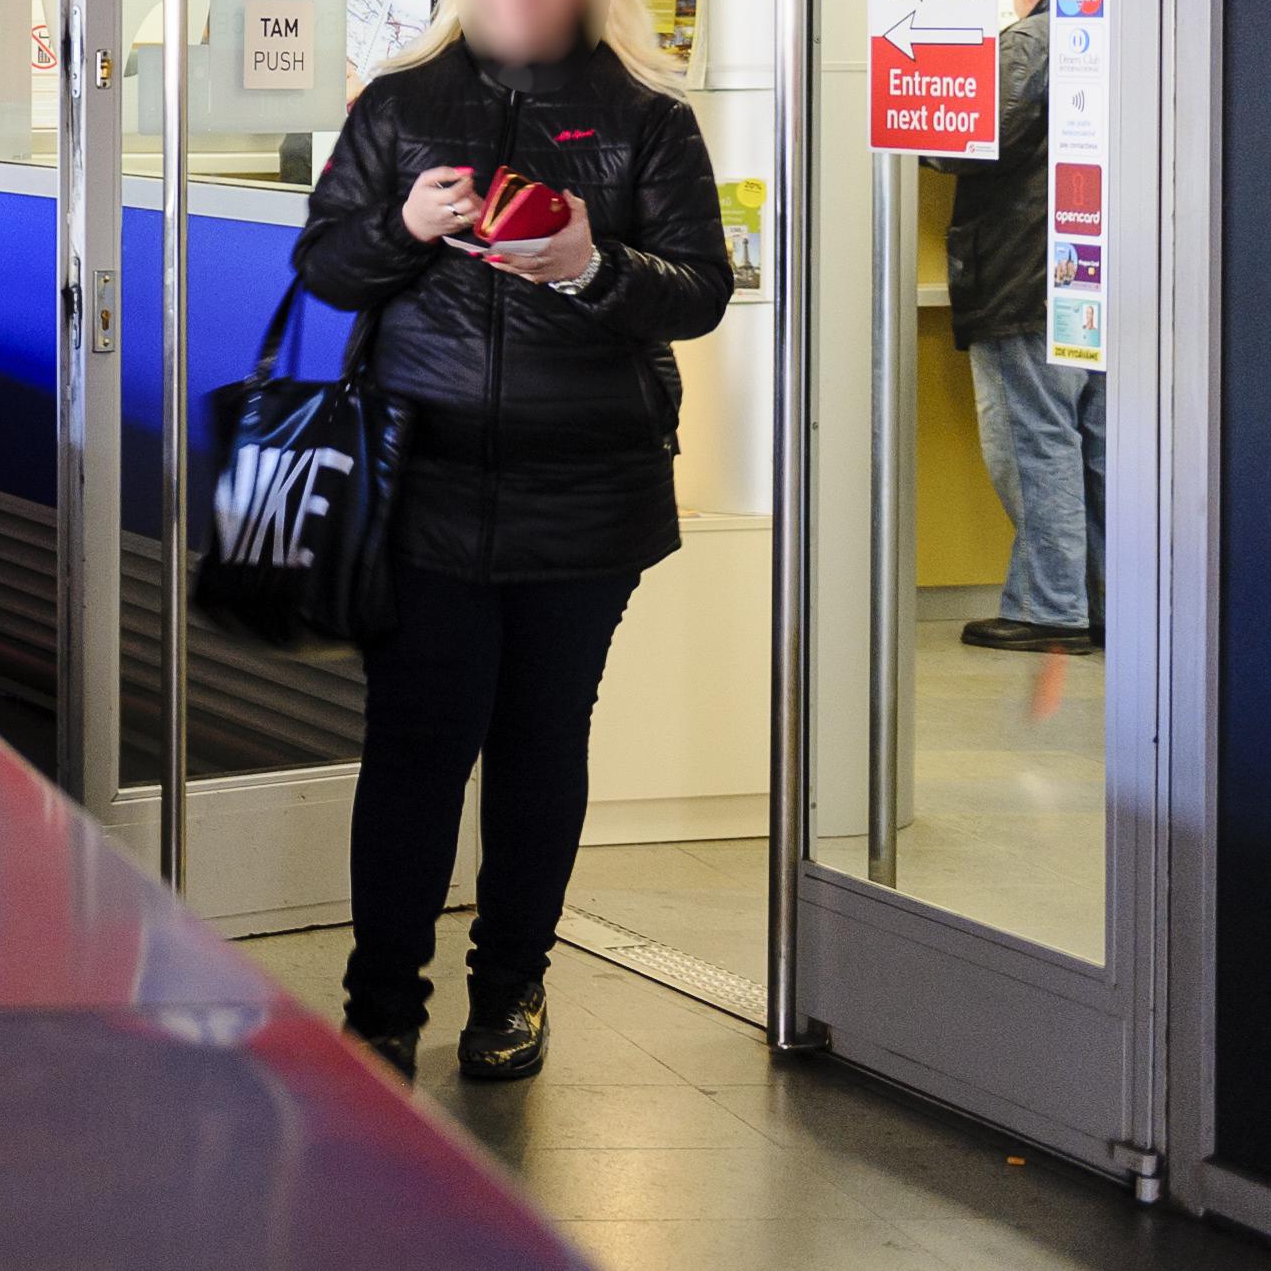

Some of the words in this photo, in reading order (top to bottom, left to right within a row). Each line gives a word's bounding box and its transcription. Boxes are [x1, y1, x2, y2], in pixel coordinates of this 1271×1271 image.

[260, 17, 299, 38] TAM
[253, 50, 305, 72] PUSH
[888, 67, 978, 99] Entrance
[886, 104, 929, 132] next
[932, 104, 980, 134] door
[1055, 210, 1101, 226] opencard
[214, 443, 355, 569] NIKE
